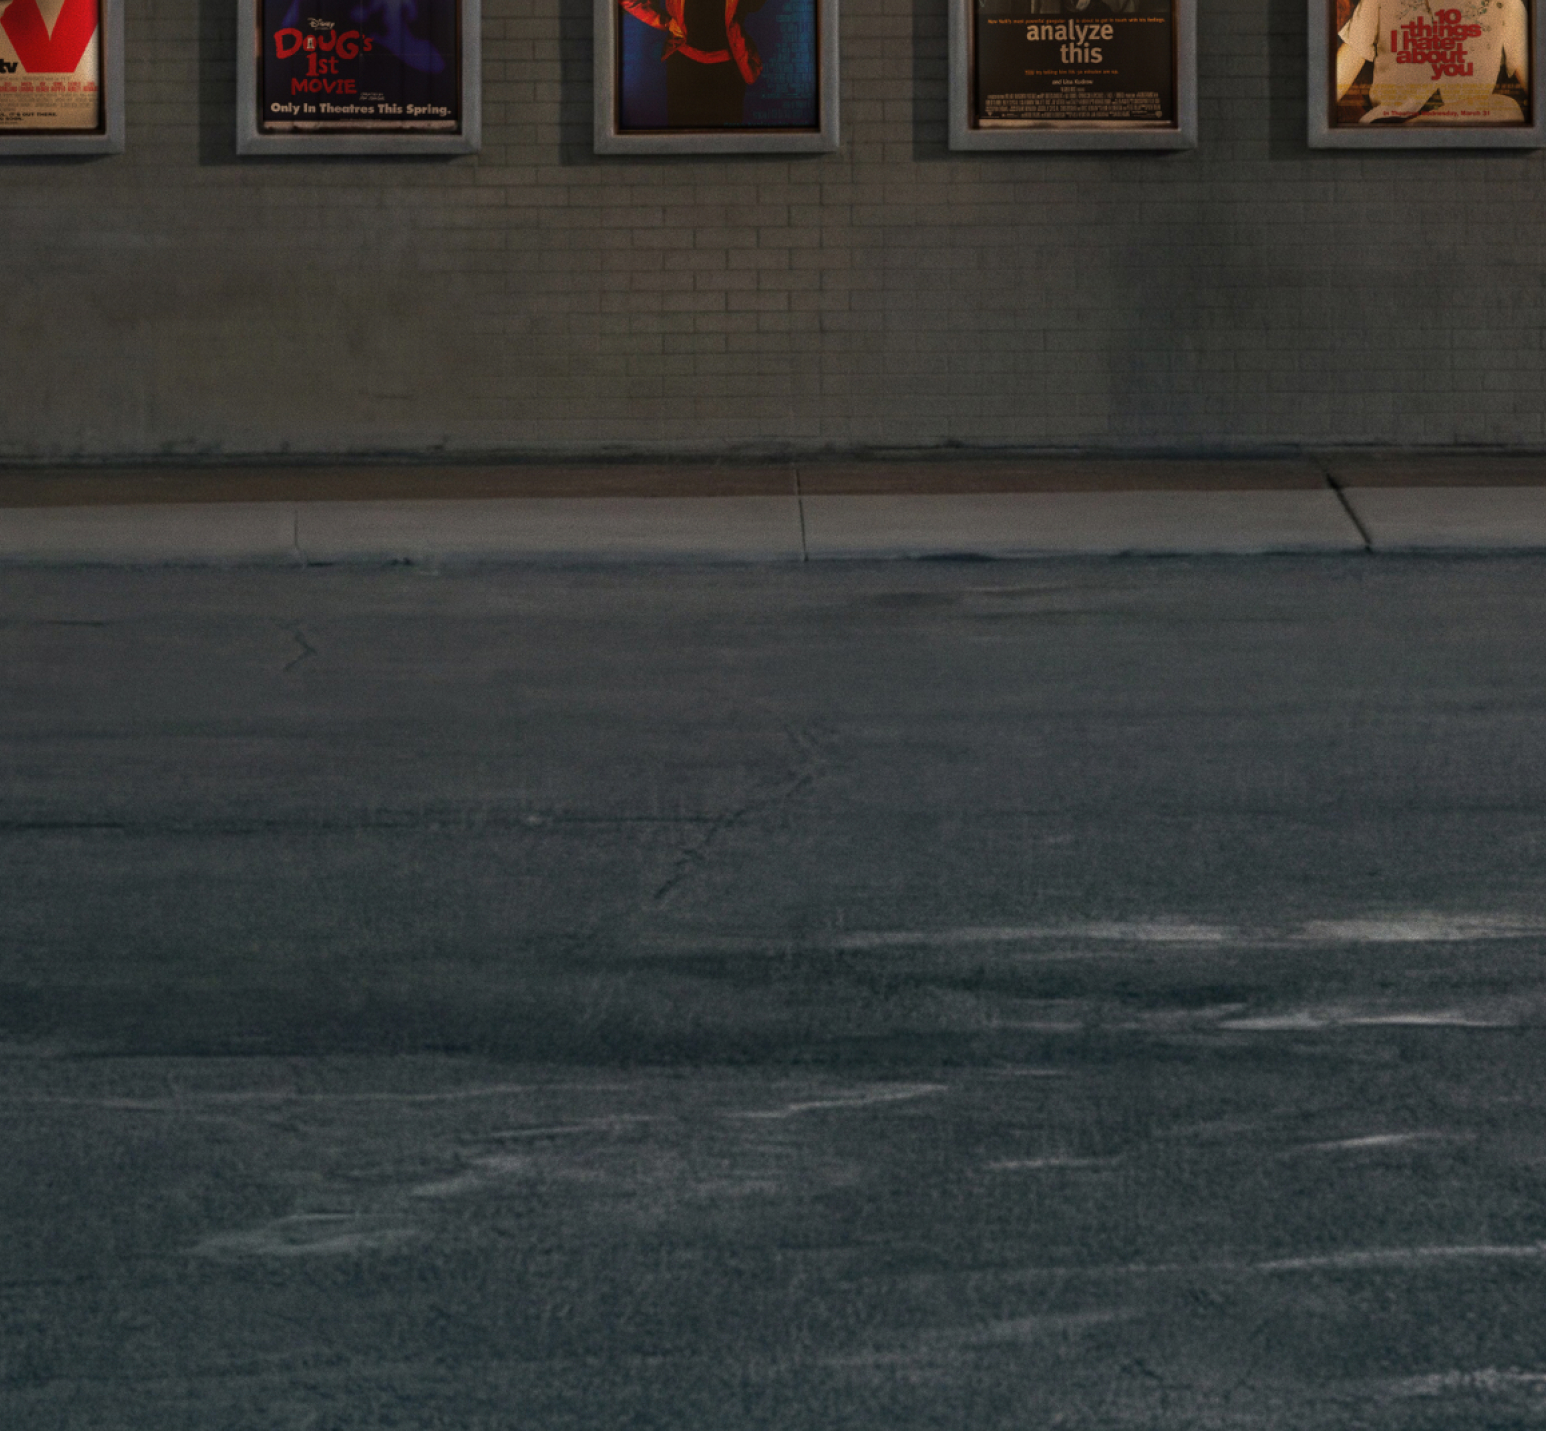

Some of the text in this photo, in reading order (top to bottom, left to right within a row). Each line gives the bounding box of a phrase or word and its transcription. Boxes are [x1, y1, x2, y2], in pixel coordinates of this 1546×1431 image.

[1435, 8, 1462, 25] 10
[1026, 19, 1114, 45] analyze
[1400, 16, 1482, 41] things
[1391, 30, 1456, 53] I hate
[1060, 42, 1104, 64] this
[1397, 42, 1468, 64] about
[305, 52, 339, 77] 1st
[1431, 62, 1474, 81] you
[290, 78, 358, 96] MOVIE
[270, 102, 452, 117] Only In Theatres This Spring.
